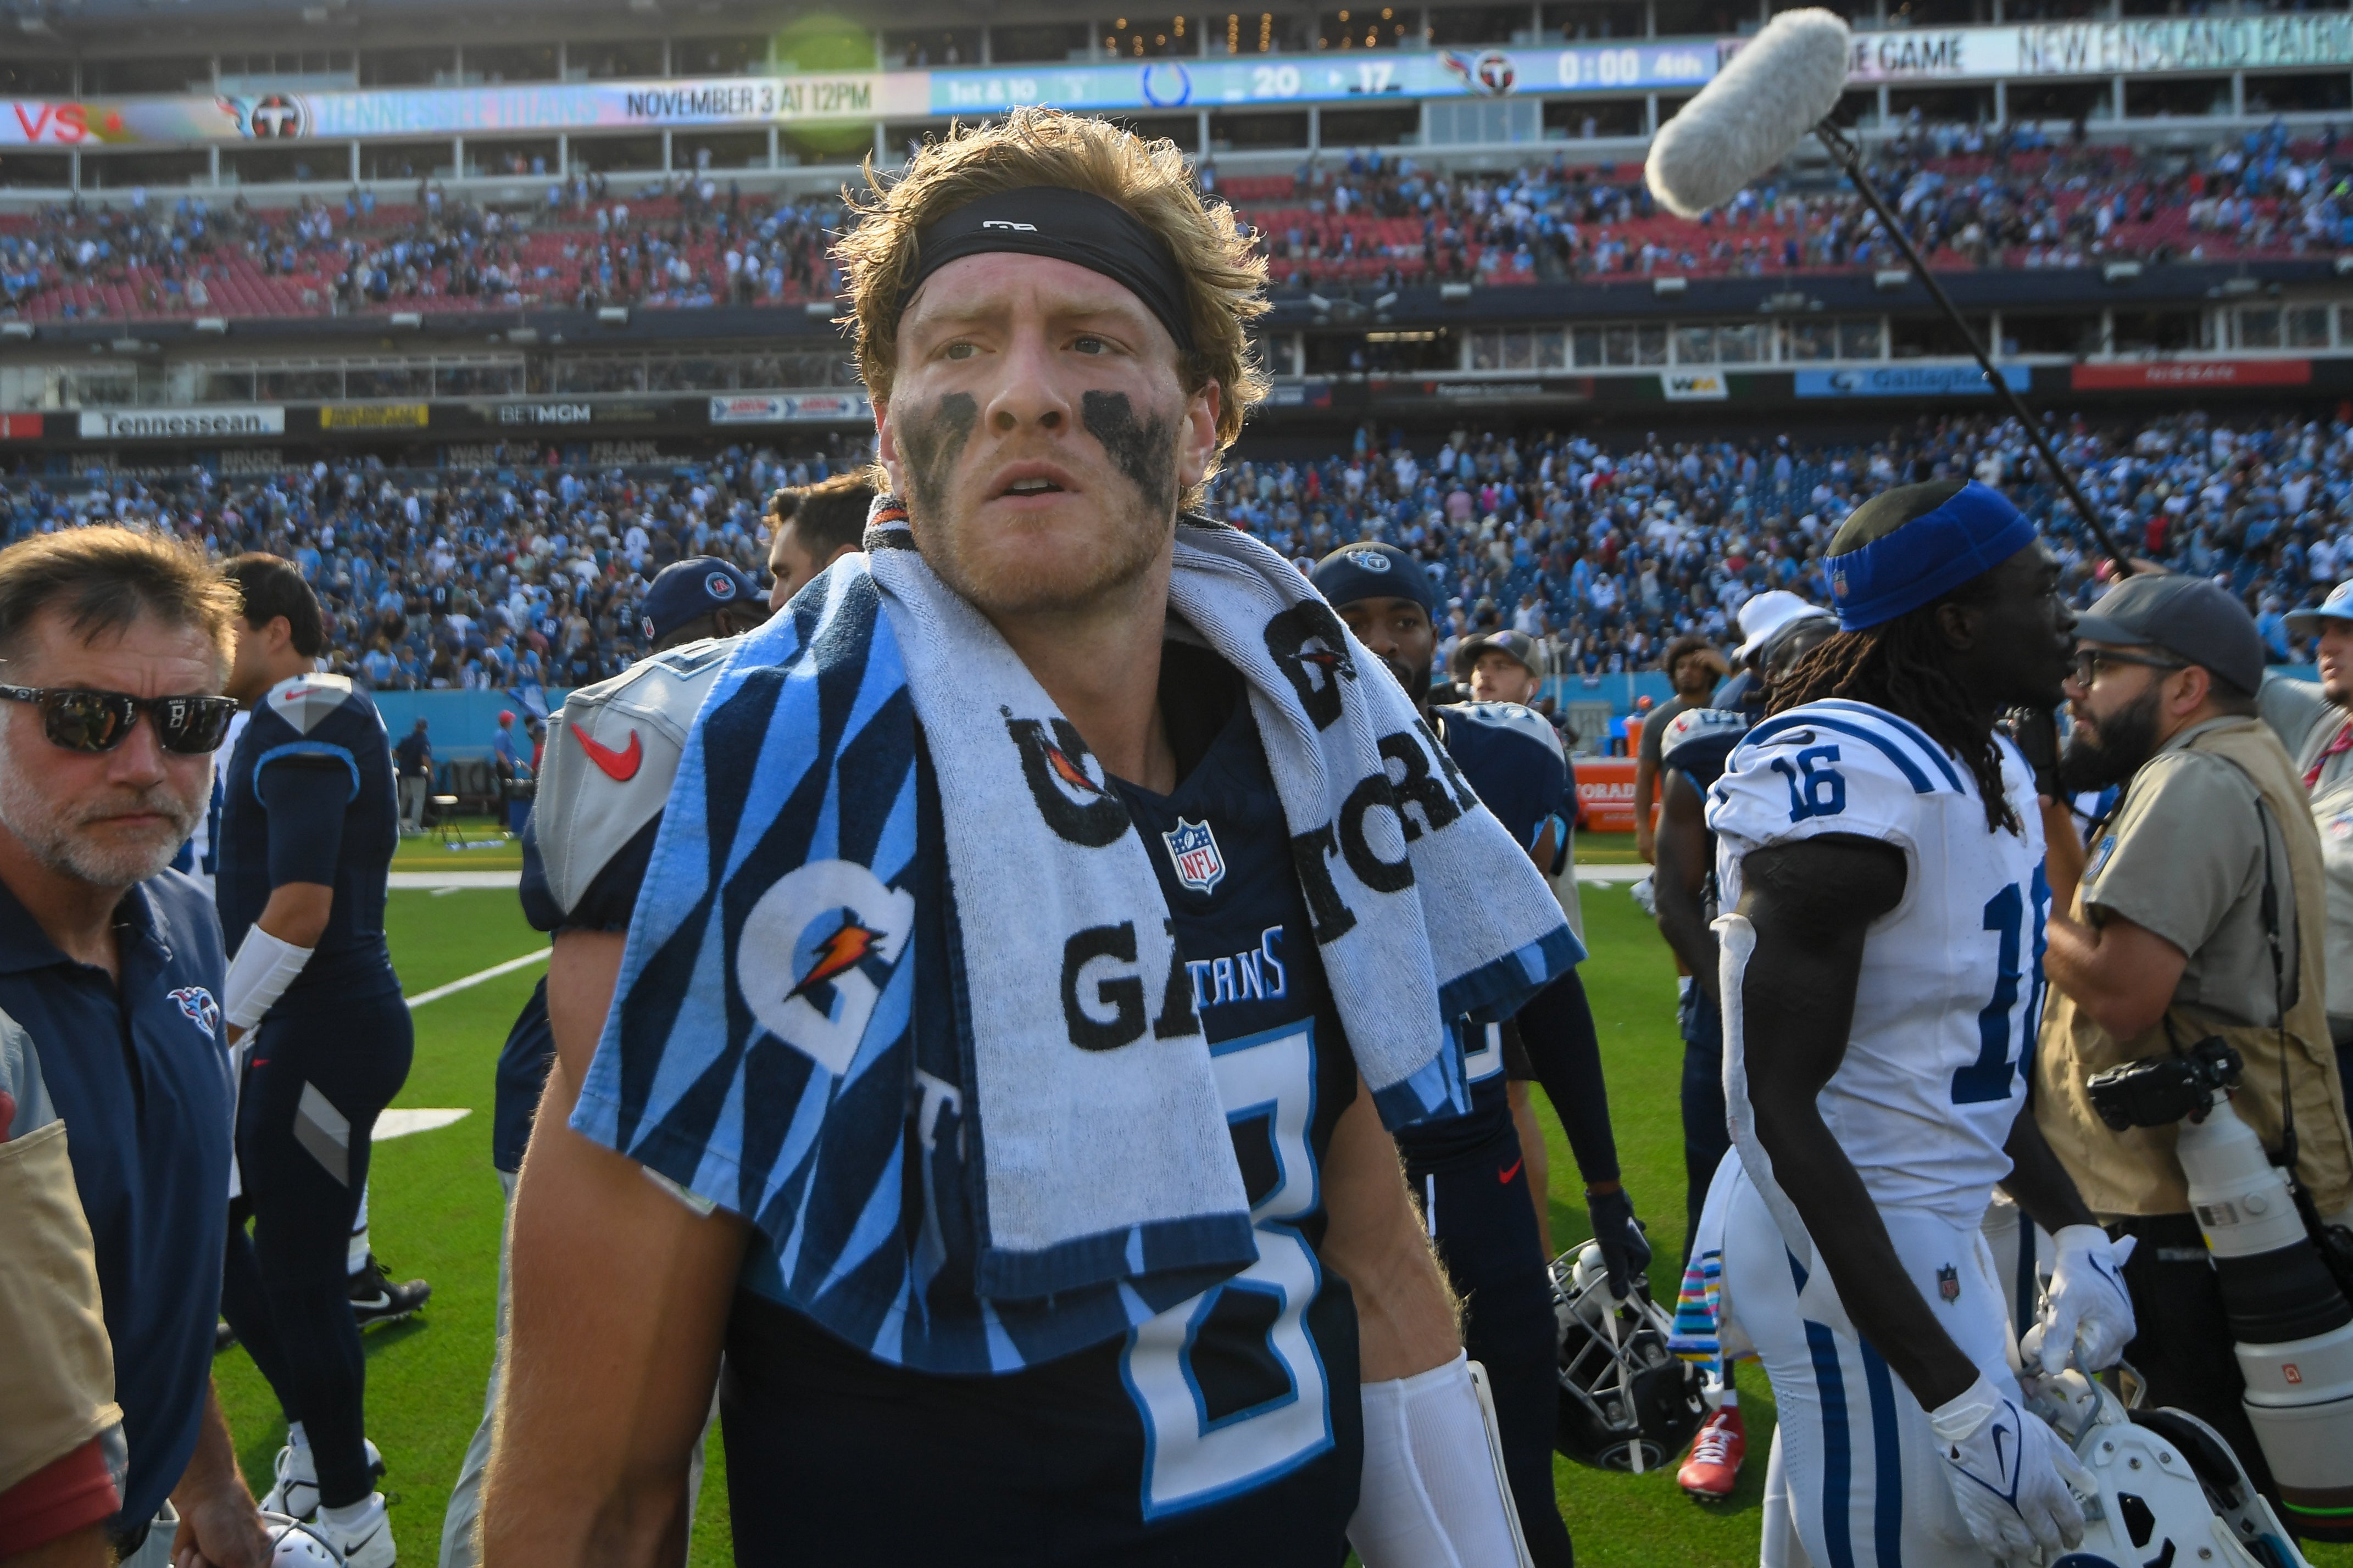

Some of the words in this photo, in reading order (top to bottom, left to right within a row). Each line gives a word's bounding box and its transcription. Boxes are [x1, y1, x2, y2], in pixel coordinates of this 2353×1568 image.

[1559, 50, 1639, 85] 0:00
[1879, 36, 1963, 72] GAME
[1253, 65, 1300, 97] 20
[1358, 61, 1395, 94] 17
[626, 87, 753, 119] NOVEMBER
[761, 86, 775, 113] 3
[780, 84, 804, 110] AT
[813, 82, 871, 111] 12PM
[14, 102, 88, 144] VS
[104, 412, 263, 434] Tennessean
[1576, 783, 1636, 799] ORAD
[1770, 744, 1846, 823] 16
[1180, 849, 1218, 880] NFL
[1184, 923, 1288, 1009] TANS
